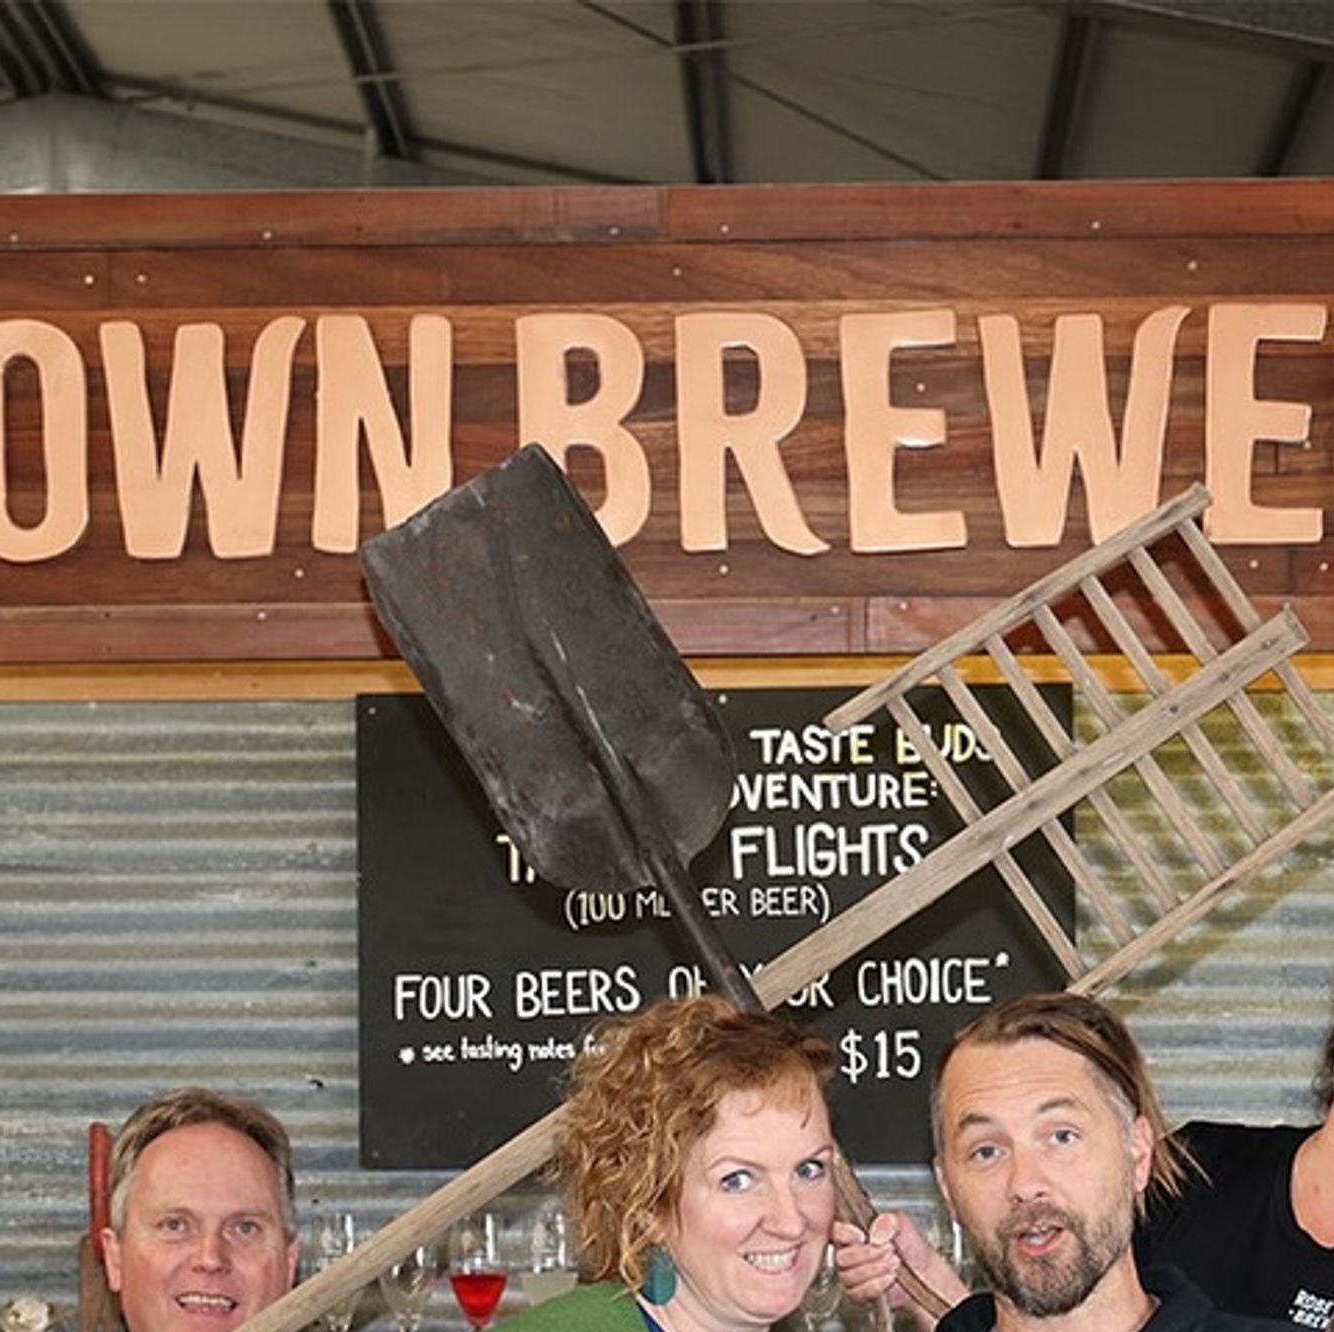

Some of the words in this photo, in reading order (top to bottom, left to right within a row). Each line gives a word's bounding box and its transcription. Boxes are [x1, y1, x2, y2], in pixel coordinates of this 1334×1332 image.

[749, 726, 875, 766] TASTE
[731, 771, 939, 811] VENTURE:
[729, 822, 930, 880] FLIGHTS
[751, 884, 831, 923] BEER)
[394, 973, 494, 1020] FOUR
[516, 966, 642, 1019] BEERS
[422, 1043, 456, 1062] see
[461, 1034, 523, 1072] tasting
[528, 1038, 576, 1060] notes
[839, 1028, 921, 1084] $15
